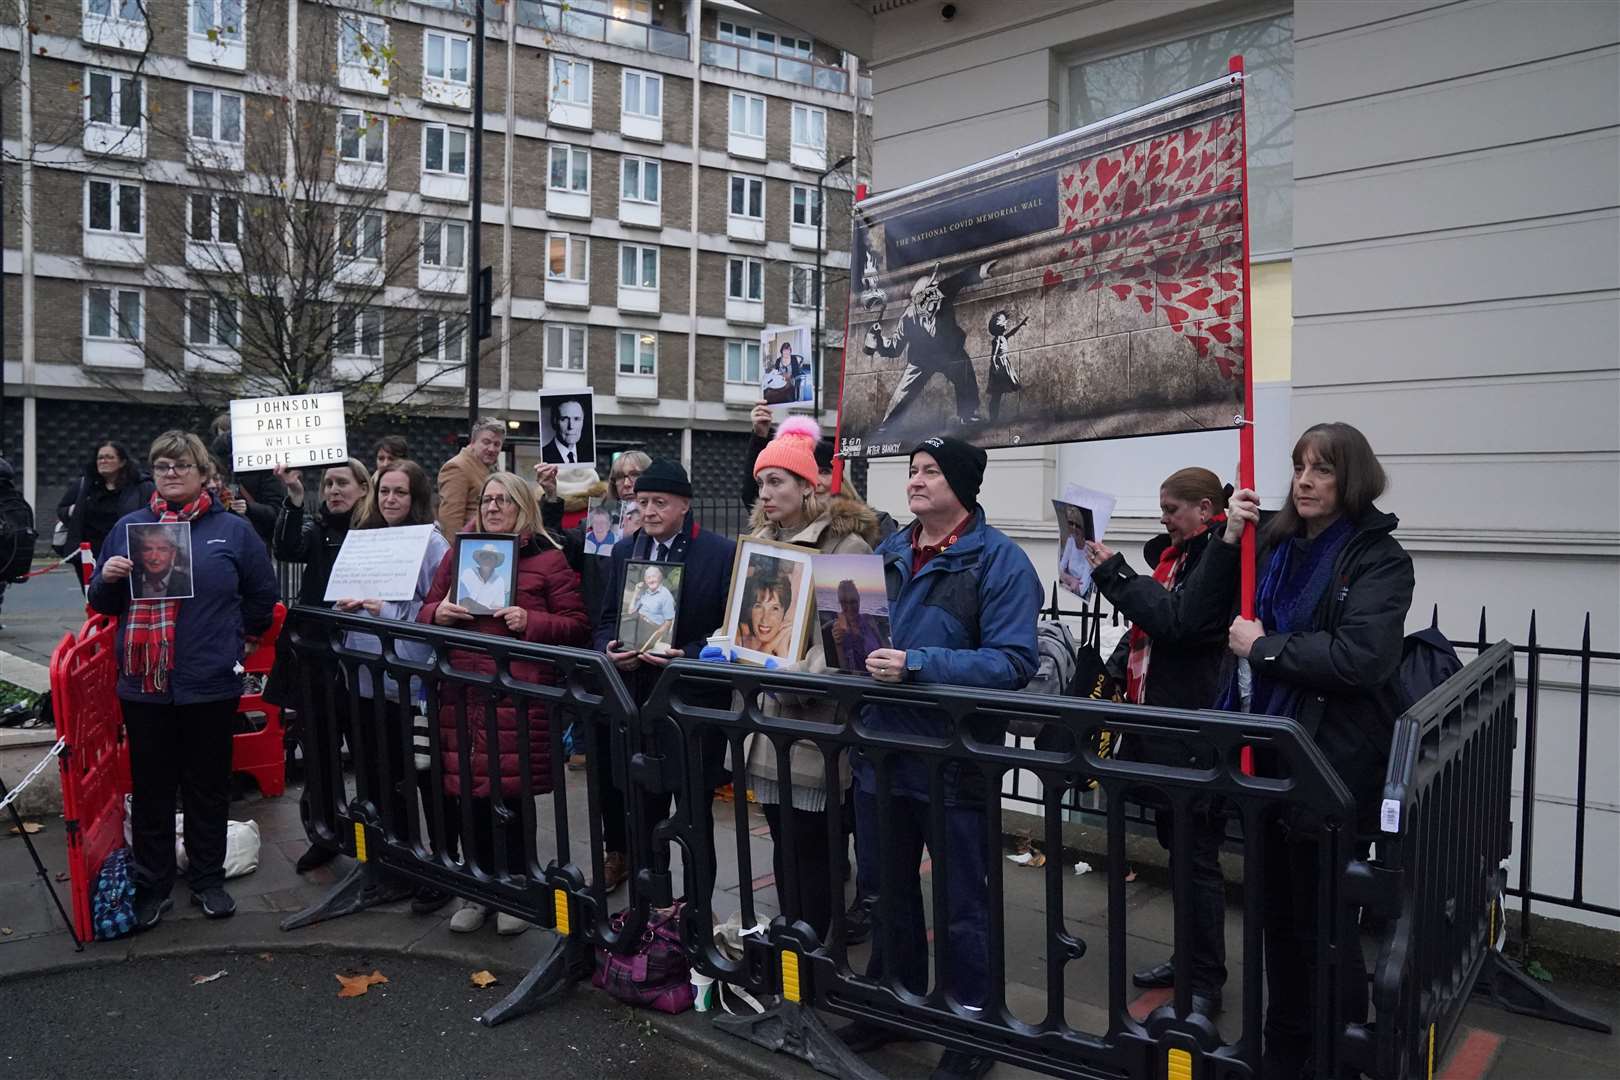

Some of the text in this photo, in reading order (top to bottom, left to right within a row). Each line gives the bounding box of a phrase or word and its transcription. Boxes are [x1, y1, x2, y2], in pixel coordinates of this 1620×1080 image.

[895, 198, 1043, 247] THE NATIONAL COVID MEMORIAL WALL
[256, 398, 319, 414] JOHNSON
[257, 415, 321, 431] PARTIED
[265, 434, 311, 447] WHILE
[237, 448, 343, 467] PEOPLE DIED
